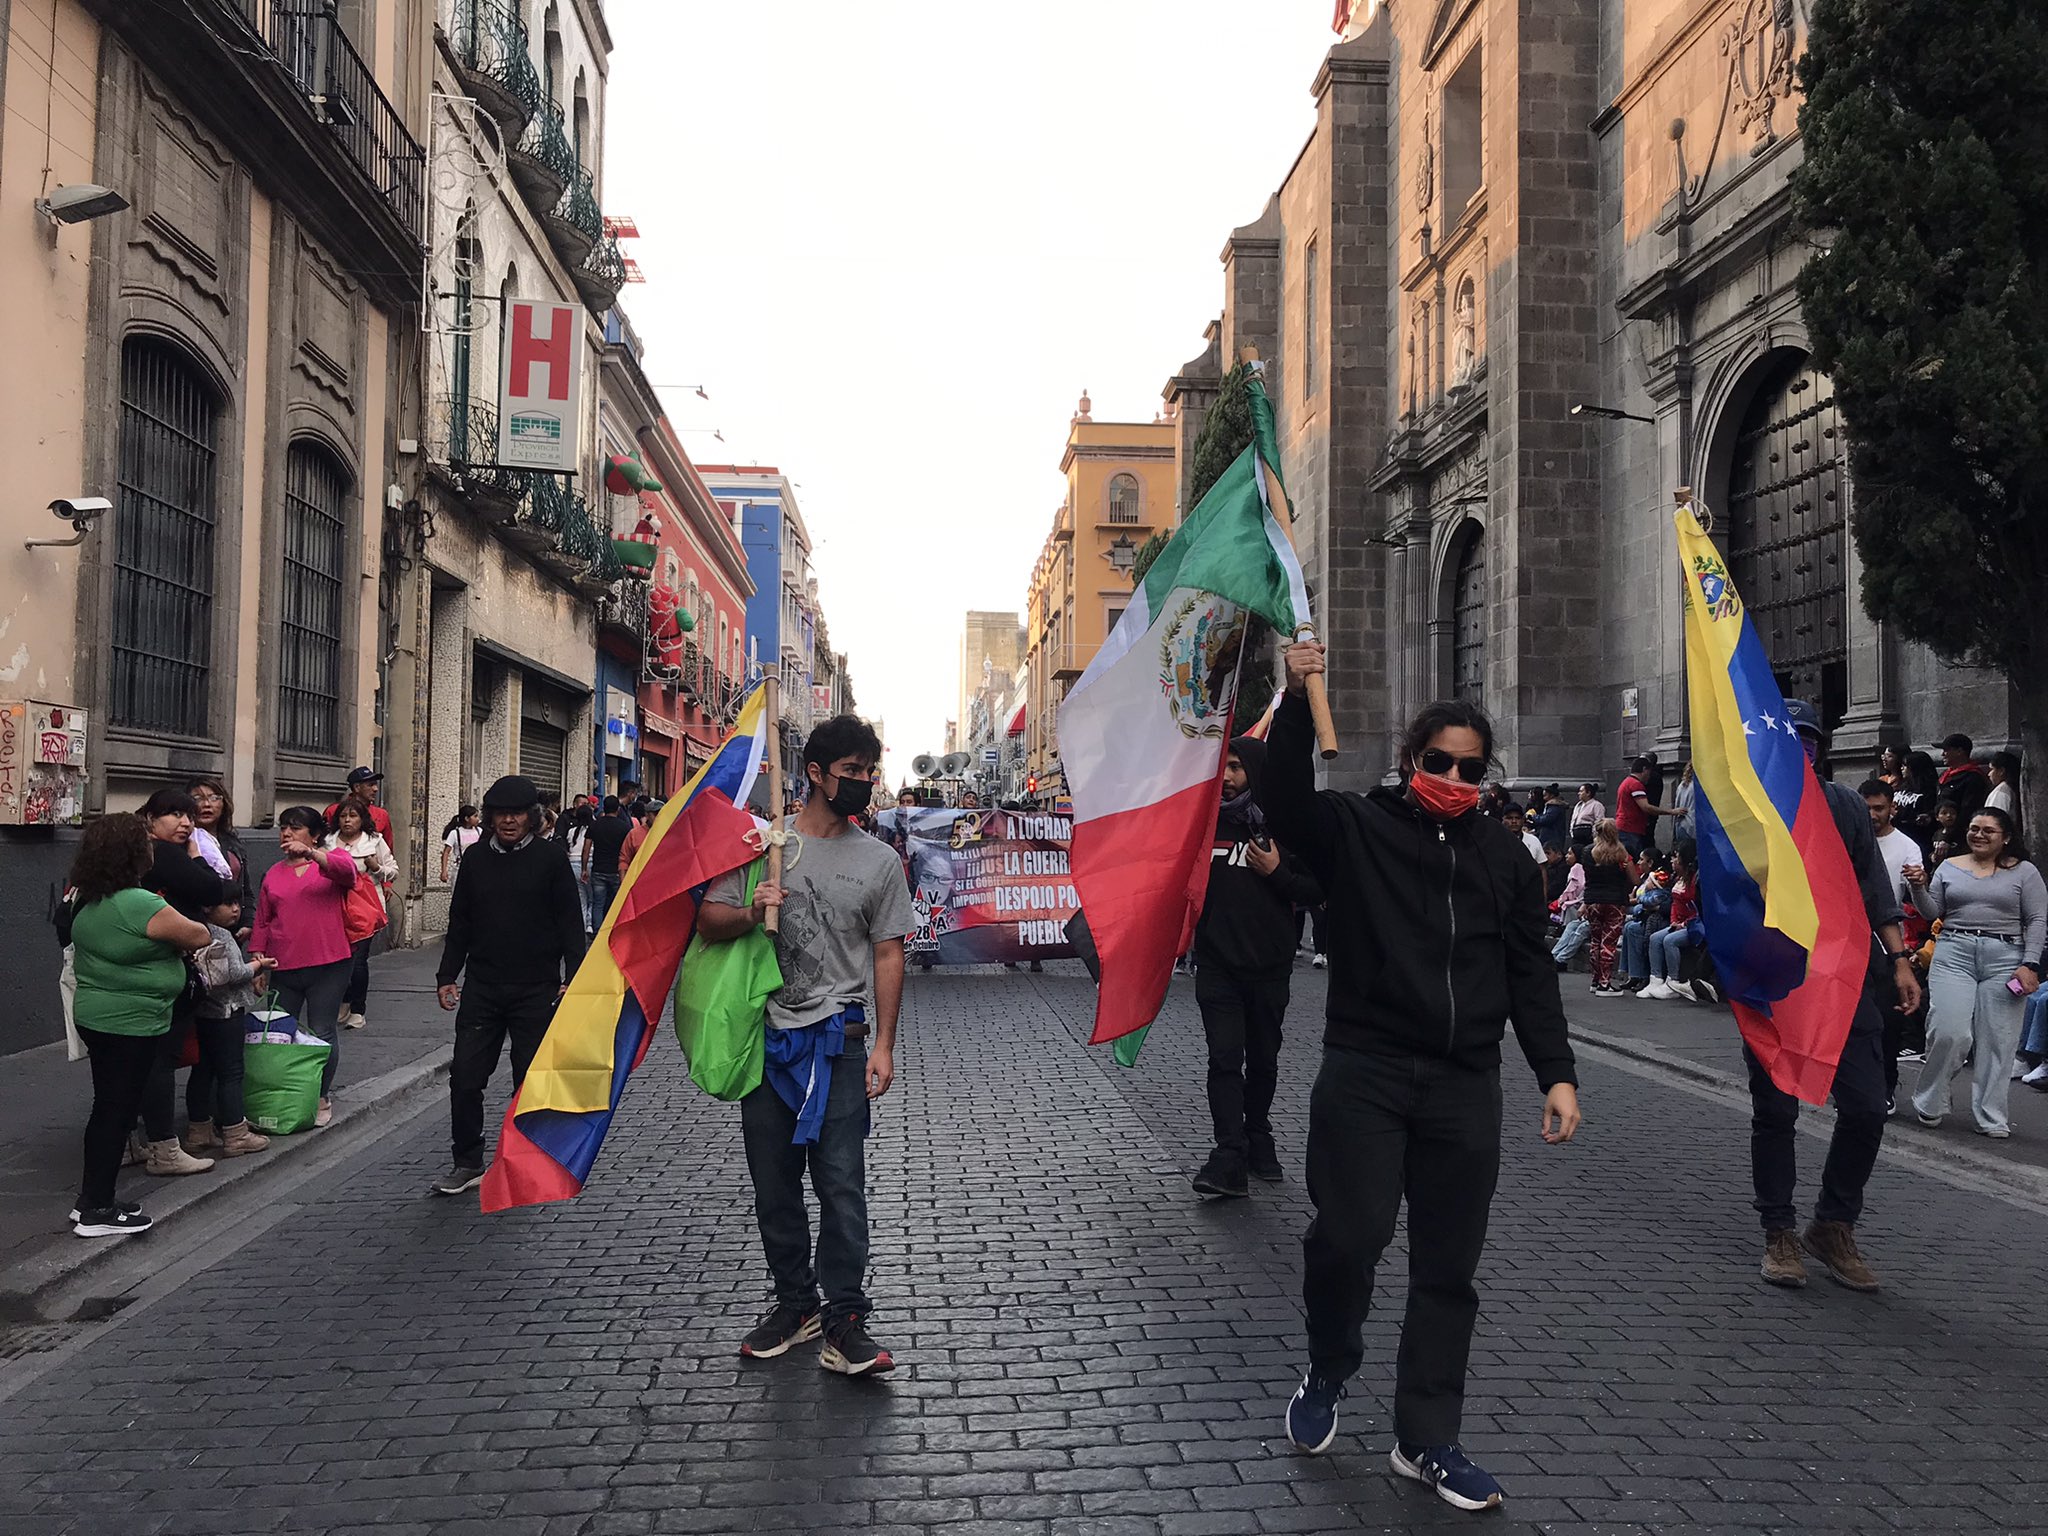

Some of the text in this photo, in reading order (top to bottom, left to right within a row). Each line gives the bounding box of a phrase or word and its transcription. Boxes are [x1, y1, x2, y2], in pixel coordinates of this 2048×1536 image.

[509, 304, 572, 400] H
[511, 449, 560, 459] Express
[1007, 816, 1072, 840] A LUCHAR
[1004, 851, 1020, 875] LA
[1023, 850, 1071, 875] GUERR
[995, 885, 1082, 911] DESPOJO PO
[916, 926, 930, 940] 28
